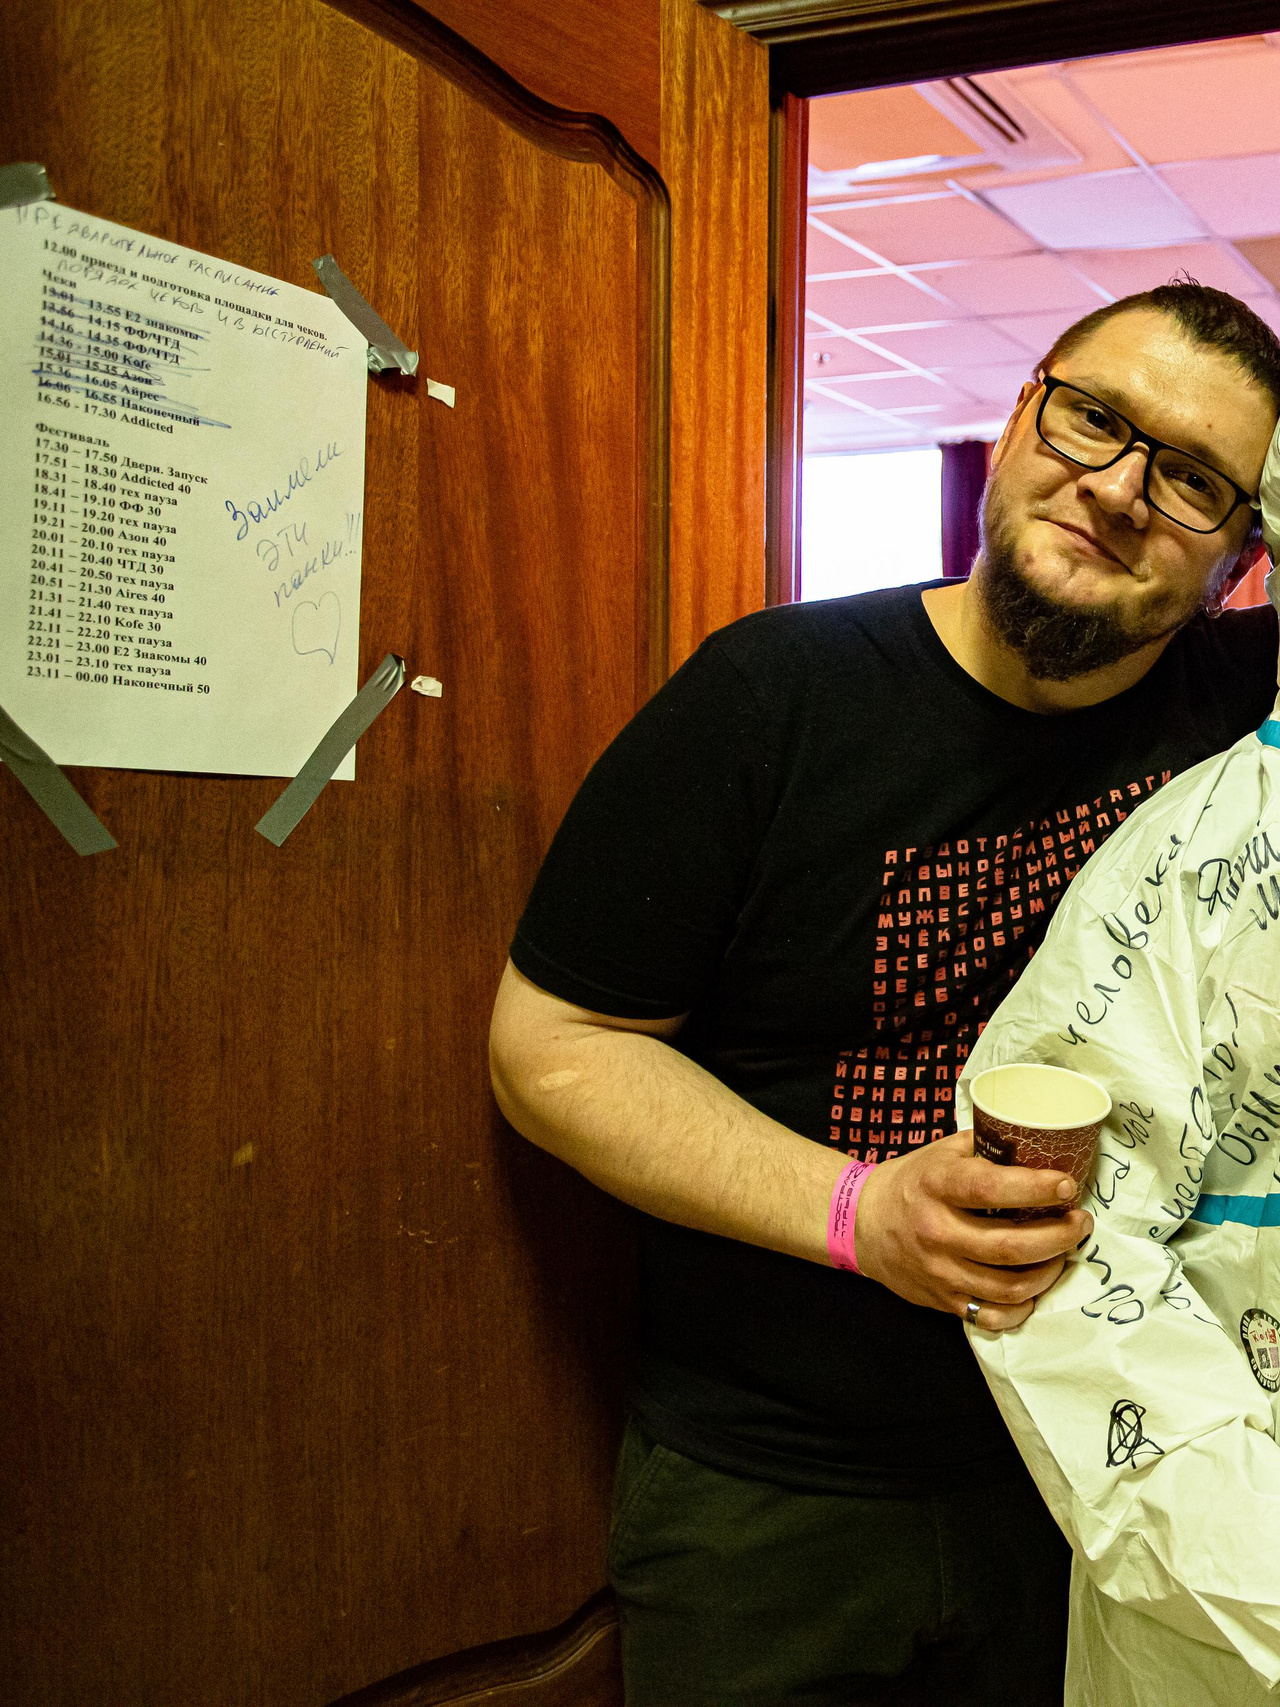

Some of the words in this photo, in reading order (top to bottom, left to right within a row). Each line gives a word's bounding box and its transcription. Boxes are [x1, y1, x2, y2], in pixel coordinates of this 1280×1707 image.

[42, 268, 77, 289] Чеки
[43, 238, 77, 258] 12.00
[80, 253, 126, 275] приезд
[129, 269, 138, 278] и
[141, 273, 211, 302] подготовка
[214, 297, 272, 322] площадки
[274, 317, 294, 329] для
[296, 324, 327, 340] чеков.
[37, 391, 71, 408] 16.56
[84, 403, 117, 420] 17.30
[120, 413, 173, 434] Addicted
[34, 422, 110, 448] Фестиваль
[35, 436, 69, 453] 17.30
[85, 448, 118, 464] 17.50
[120, 456, 163, 474] Двери.
[167, 466, 208, 484] Запуск
[35, 452, 67, 468] 17.51
[85, 463, 117, 479] 18.30
[120, 471, 174, 491] Addicted
[177, 483, 191, 494] 40
[34, 483, 66, 498] 18.41
[83, 492, 116, 508] 19.10
[119, 500, 144, 513] ФФ
[147, 505, 161, 517] 30
[35, 467, 66, 483] 18.31
[84, 478, 116, 493] 18.40
[120, 487, 140, 498] тех
[144, 492, 178, 506] пауза
[33, 513, 64, 529] 19.21
[81, 522, 114, 537] 20.00
[117, 530, 149, 544] Азон
[152, 536, 167, 547] 40
[34, 497, 65, 513] 19.11
[83, 507, 115, 523] 19.20
[119, 517, 139, 527] тех
[142, 521, 177, 534] пауза
[31, 528, 64, 544] 20.01
[80, 537, 114, 552] 20.10
[117, 546, 137, 556] тех
[141, 550, 175, 563] пауза
[31, 543, 64, 559] 20.11
[80, 551, 113, 567] 20.40
[117, 558, 147, 574] ЧТД
[149, 563, 164, 575] 30
[30, 558, 63, 573] 20.41
[79, 566, 113, 581] 20.50
[116, 575, 136, 585] тех
[140, 579, 174, 591] пауза
[30, 573, 63, 588] 20.51
[79, 581, 112, 596] 21.30
[115, 588, 148, 601] Aires
[151, 593, 165, 603] 40
[29, 588, 62, 603] 21.31
[78, 596, 111, 610] 21.40
[115, 604, 135, 614] тех
[139, 607, 173, 620] пауза
[29, 604, 61, 619] 21.41
[78, 611, 111, 625] 22.10
[115, 616, 144, 630] Kofe
[147, 621, 161, 632] 30
[28, 619, 60, 634] 22.11
[77, 626, 110, 640] 22.20
[114, 633, 133, 643] тех
[138, 637, 172, 648] пауза
[27, 634, 60, 649] 22.21
[76, 641, 110, 654] 23.00
[134, 648, 190, 664] Знакомы
[193, 655, 207, 666] 40
[27, 650, 59, 664] 23.01
[76, 656, 109, 669] 23.10
[113, 663, 133, 672] тех
[137, 665, 171, 677] пауза
[26, 665, 59, 679] 23.11
[75, 671, 109, 684] 00.00
[112, 674, 193, 693] Наконечный
[197, 683, 210, 694] 50
